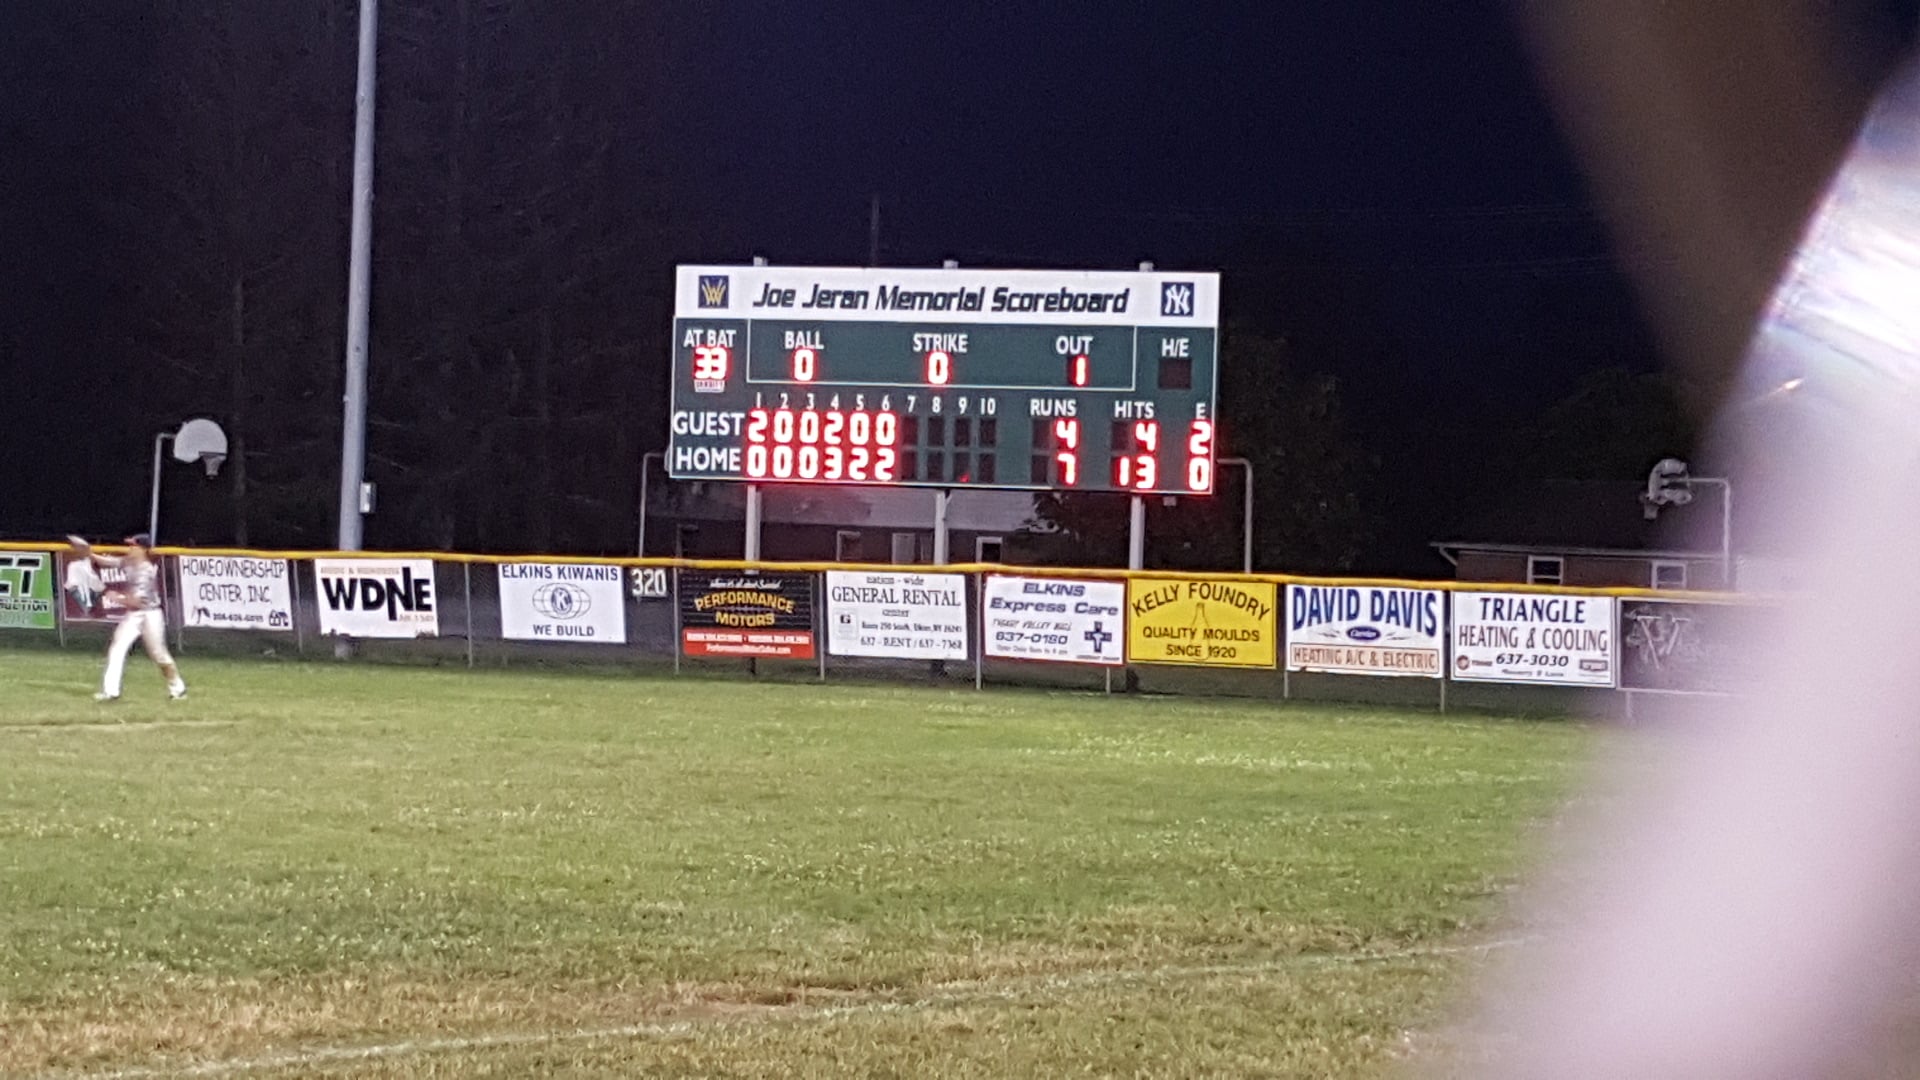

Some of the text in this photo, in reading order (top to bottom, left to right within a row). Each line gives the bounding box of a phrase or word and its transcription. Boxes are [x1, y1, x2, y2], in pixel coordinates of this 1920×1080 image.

[753, 283, 1130, 313] Joe Jeran Memorial Scoreboard
[683, 329, 736, 348] AT BAT
[785, 331, 824, 349] BALL
[913, 333, 968, 353] STRIKE
[1055, 336, 1093, 355] OUT
[1162, 338, 1189, 357] H/E
[694, 347, 728, 380] 33
[793, 349, 814, 382] 0
[928, 352, 948, 384] 0
[1075, 356, 1087, 385] 1
[755, 392, 996, 415] 1 2 3 4 5 6 7 8 9 10
[1030, 399, 1077, 417] RUNS
[1114, 400, 1154, 419] HITS
[1195, 402, 1206, 419] E
[673, 411, 745, 436] GUEST
[748, 410, 896, 445] 2 0 0 2 0 0
[1056, 420, 1077, 449] 4
[1136, 422, 1156, 452] 4
[1189, 421, 1211, 454] 2
[676, 447, 741, 471] HOME
[747, 445, 895, 480] 0 0 0 3 2 2
[1057, 452, 1076, 485] 7
[1121, 455, 1156, 489] 13
[1189, 457, 1210, 490] 0
[183, 558, 285, 579] HOMEOWNERSHIP
[502, 565, 618, 581] ELKINS KIWANIS
[631, 568, 667, 597] 320
[1023, 582, 1086, 597] ELKINS
[200, 583, 246, 605] CENTER,
[321, 567, 432, 621] WDNE
[694, 591, 796, 613] PERFORMANCE
[832, 586, 961, 606] GENERAL RENTAL
[1132, 582, 1270, 621] KELLY FOUNDRY
[990, 597, 1118, 616] Express Care
[1293, 587, 1436, 638] DAVID DAVIS
[1480, 598, 1586, 623] TRIANGLE
[715, 611, 775, 627] MOTORS
[533, 624, 595, 637] WE BUILD
[1142, 626, 1260, 642] QUALITY MOULDS
[1459, 625, 1608, 651] HEATING & COOLING
[883, 637, 912, 648] RENT
[1166, 644, 1236, 658] SINCE 1920
[1294, 647, 1342, 665] HEATING
[1346, 648, 1365, 665] A/C
[1383, 652, 1436, 669] ELECTRIC
[1496, 653, 1569, 667] 637-3030
